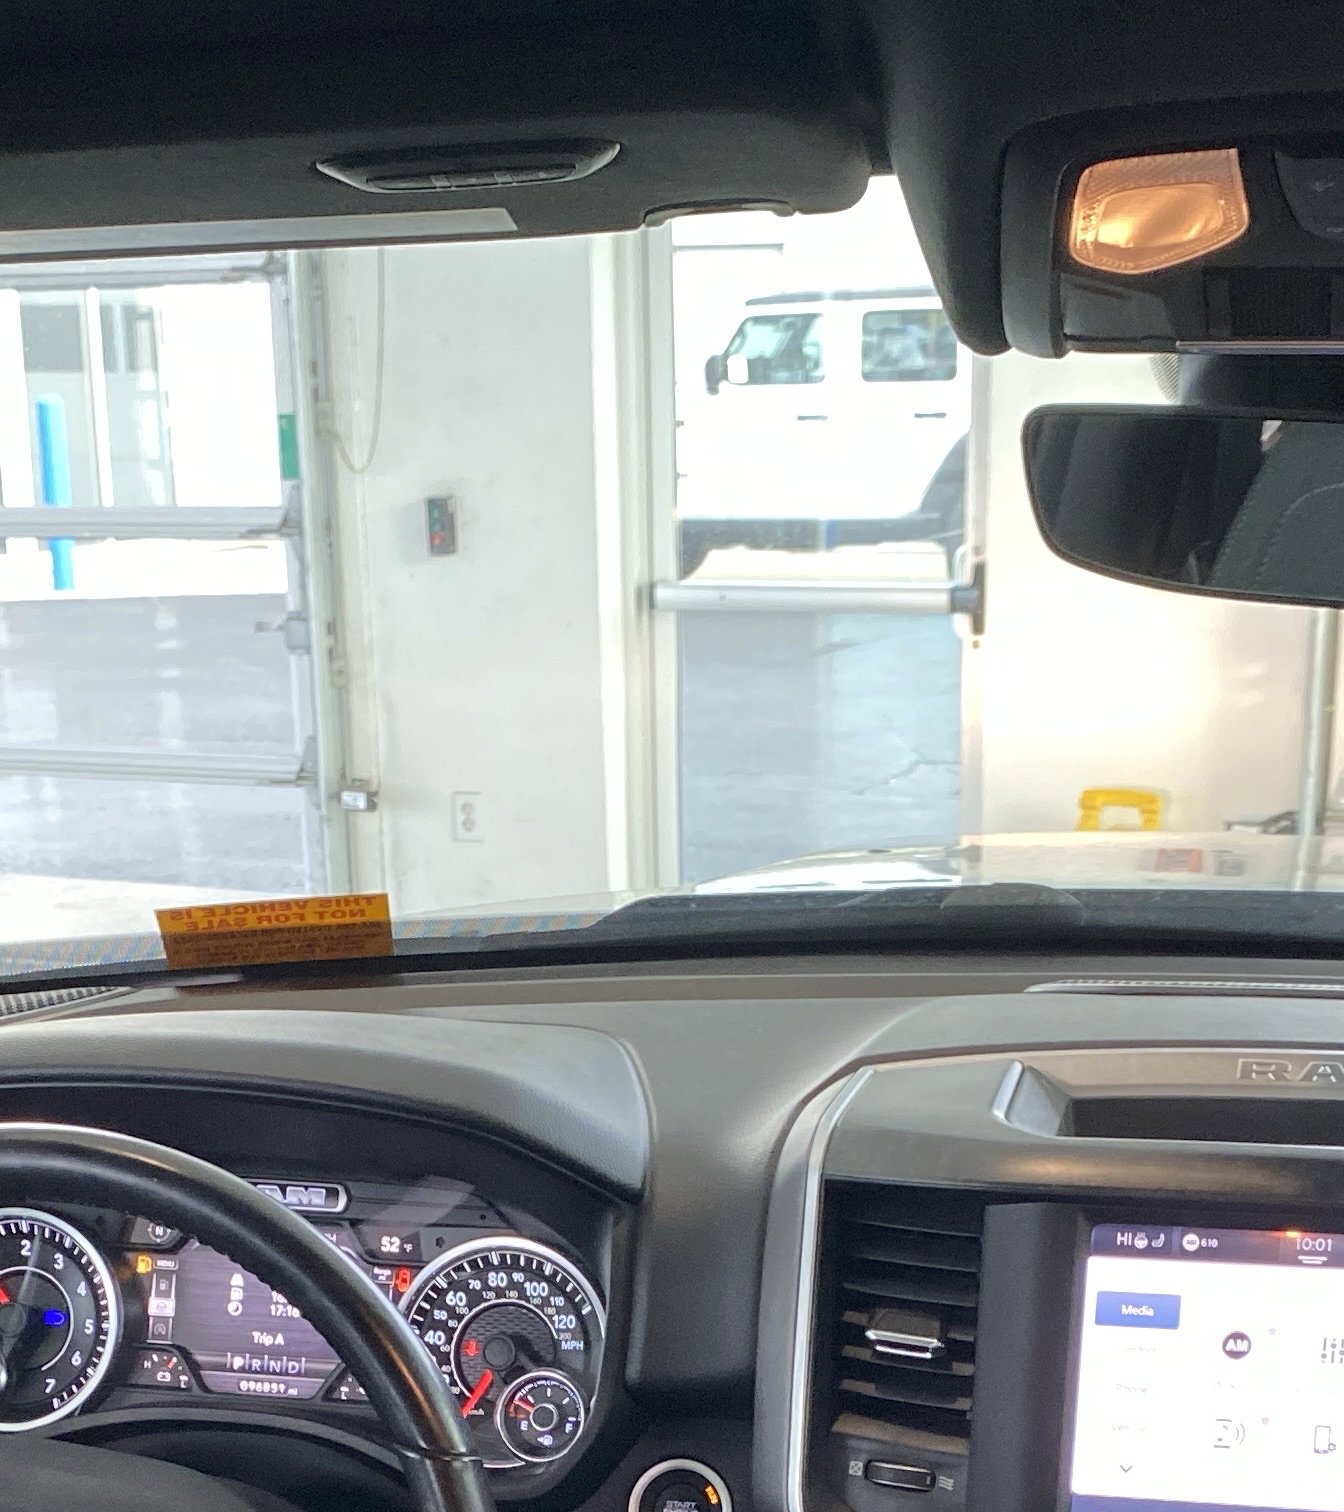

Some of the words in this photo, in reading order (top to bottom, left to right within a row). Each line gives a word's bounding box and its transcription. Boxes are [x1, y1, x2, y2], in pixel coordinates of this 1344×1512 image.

[256, 1184, 326, 1206] AM
[381, 1236, 400, 1252] 52
[1116, 1231, 1132, 1246] HI
[1295, 1238, 1332, 1251] 10:01
[20, 1239, 31, 1256] 2
[54, 1253, 64, 1270] 3
[468, 1279, 481, 1291] 70
[487, 1272, 507, 1288] 80
[511, 1272, 525, 1283] 90
[77, 1282, 87, 1296] 4
[523, 1281, 548, 1297] 100
[445, 1291, 466, 1307] 60
[549, 1296, 565, 1307] 110
[433, 1310, 448, 1321] 50
[1121, 1305, 1155, 1317] Media
[84, 1319, 94, 1334] 5
[552, 1314, 575, 1329] 120
[252, 1331, 273, 1346] Trip
[275, 1333, 284, 1345] A
[424, 1330, 445, 1346] 40
[561, 1340, 584, 1350] MPH
[1225, 1338, 1249, 1352] AM
[71, 1351, 82, 1366] 6
[233, 1356, 244, 1370] P
[251, 1358, 261, 1371] R
[269, 1360, 281, 1373] N
[288, 1361, 299, 1374] D
[45, 1379, 56, 1393] 7
[666, 1501, 696, 1509] START
